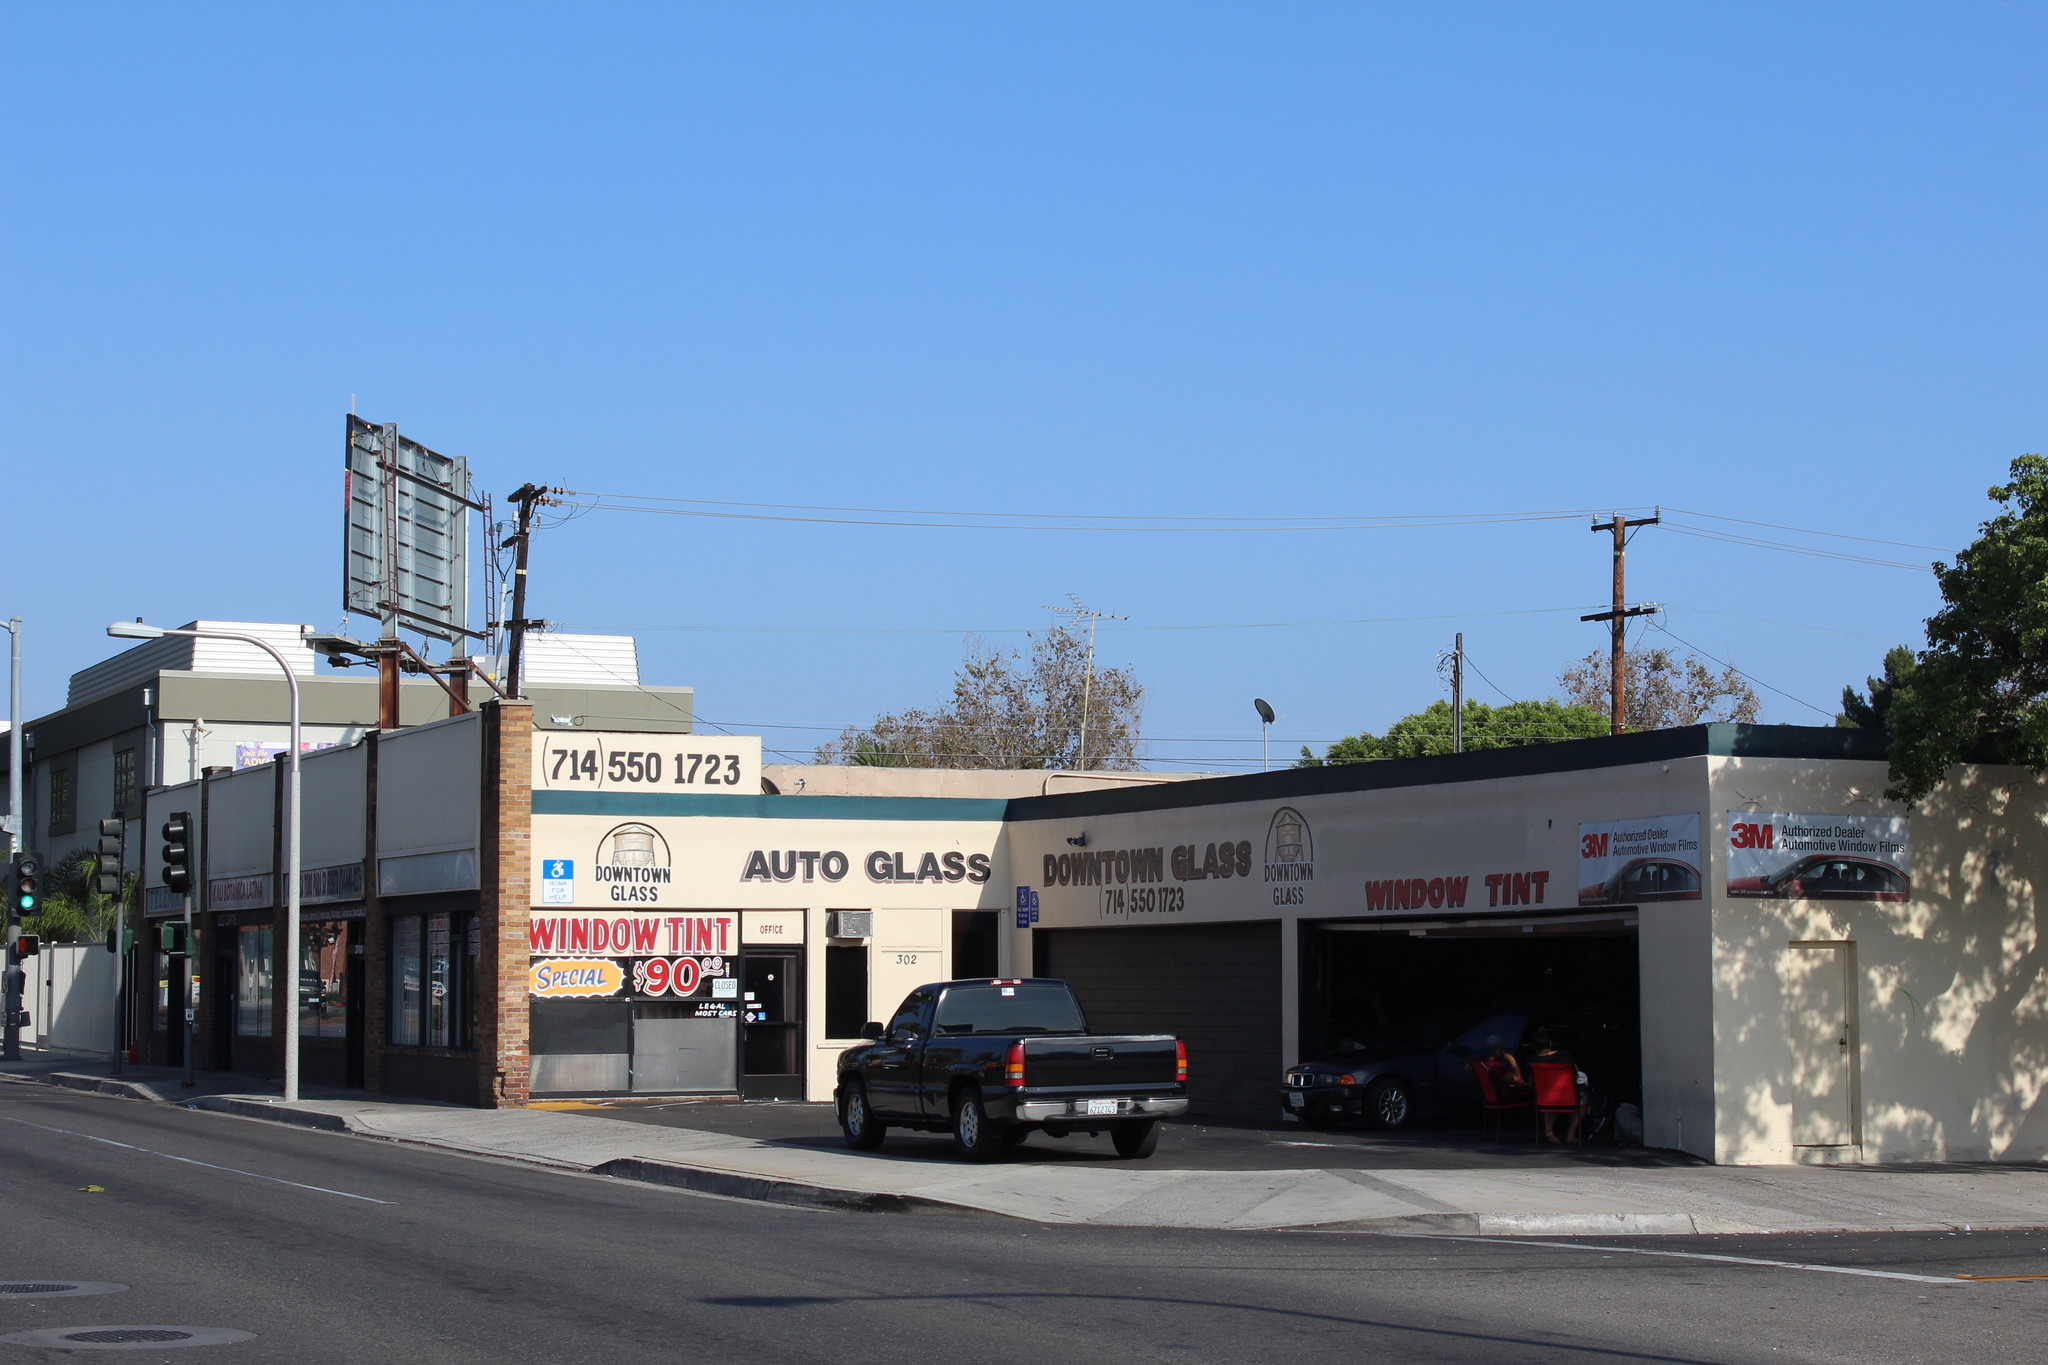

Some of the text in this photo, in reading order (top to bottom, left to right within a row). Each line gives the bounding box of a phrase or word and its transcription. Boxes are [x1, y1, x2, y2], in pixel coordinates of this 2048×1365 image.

[542, 736, 741, 788] (714) 550 1723
[1580, 828, 1669, 859] 3M Authorized Dealer
[1612, 838, 1697, 857] Automotive Window Films
[1731, 823, 1865, 850] 3M Authorized Dealer
[1781, 839, 1905, 853] Automotive Window Films
[595, 865, 671, 883] DOWNTOWN
[740, 850, 991, 884] AUTO GLASS
[1043, 840, 1252, 887] DOWNTOWN GLASS
[1264, 862, 1314, 883] DOWNTOWN
[611, 885, 658, 902] GLASS
[1099, 882, 1184, 920] (714) 550 1723
[1273, 886, 1304, 906] GLASS
[1365, 870, 1550, 911] WINDOW TINT
[530, 918, 732, 955] WINDOW TINT
[760, 925, 783, 934] OFFICE
[896, 954, 917, 965] 302
[535, 966, 608, 990] SPECIAL
[714, 980, 736, 990] CLOSED
